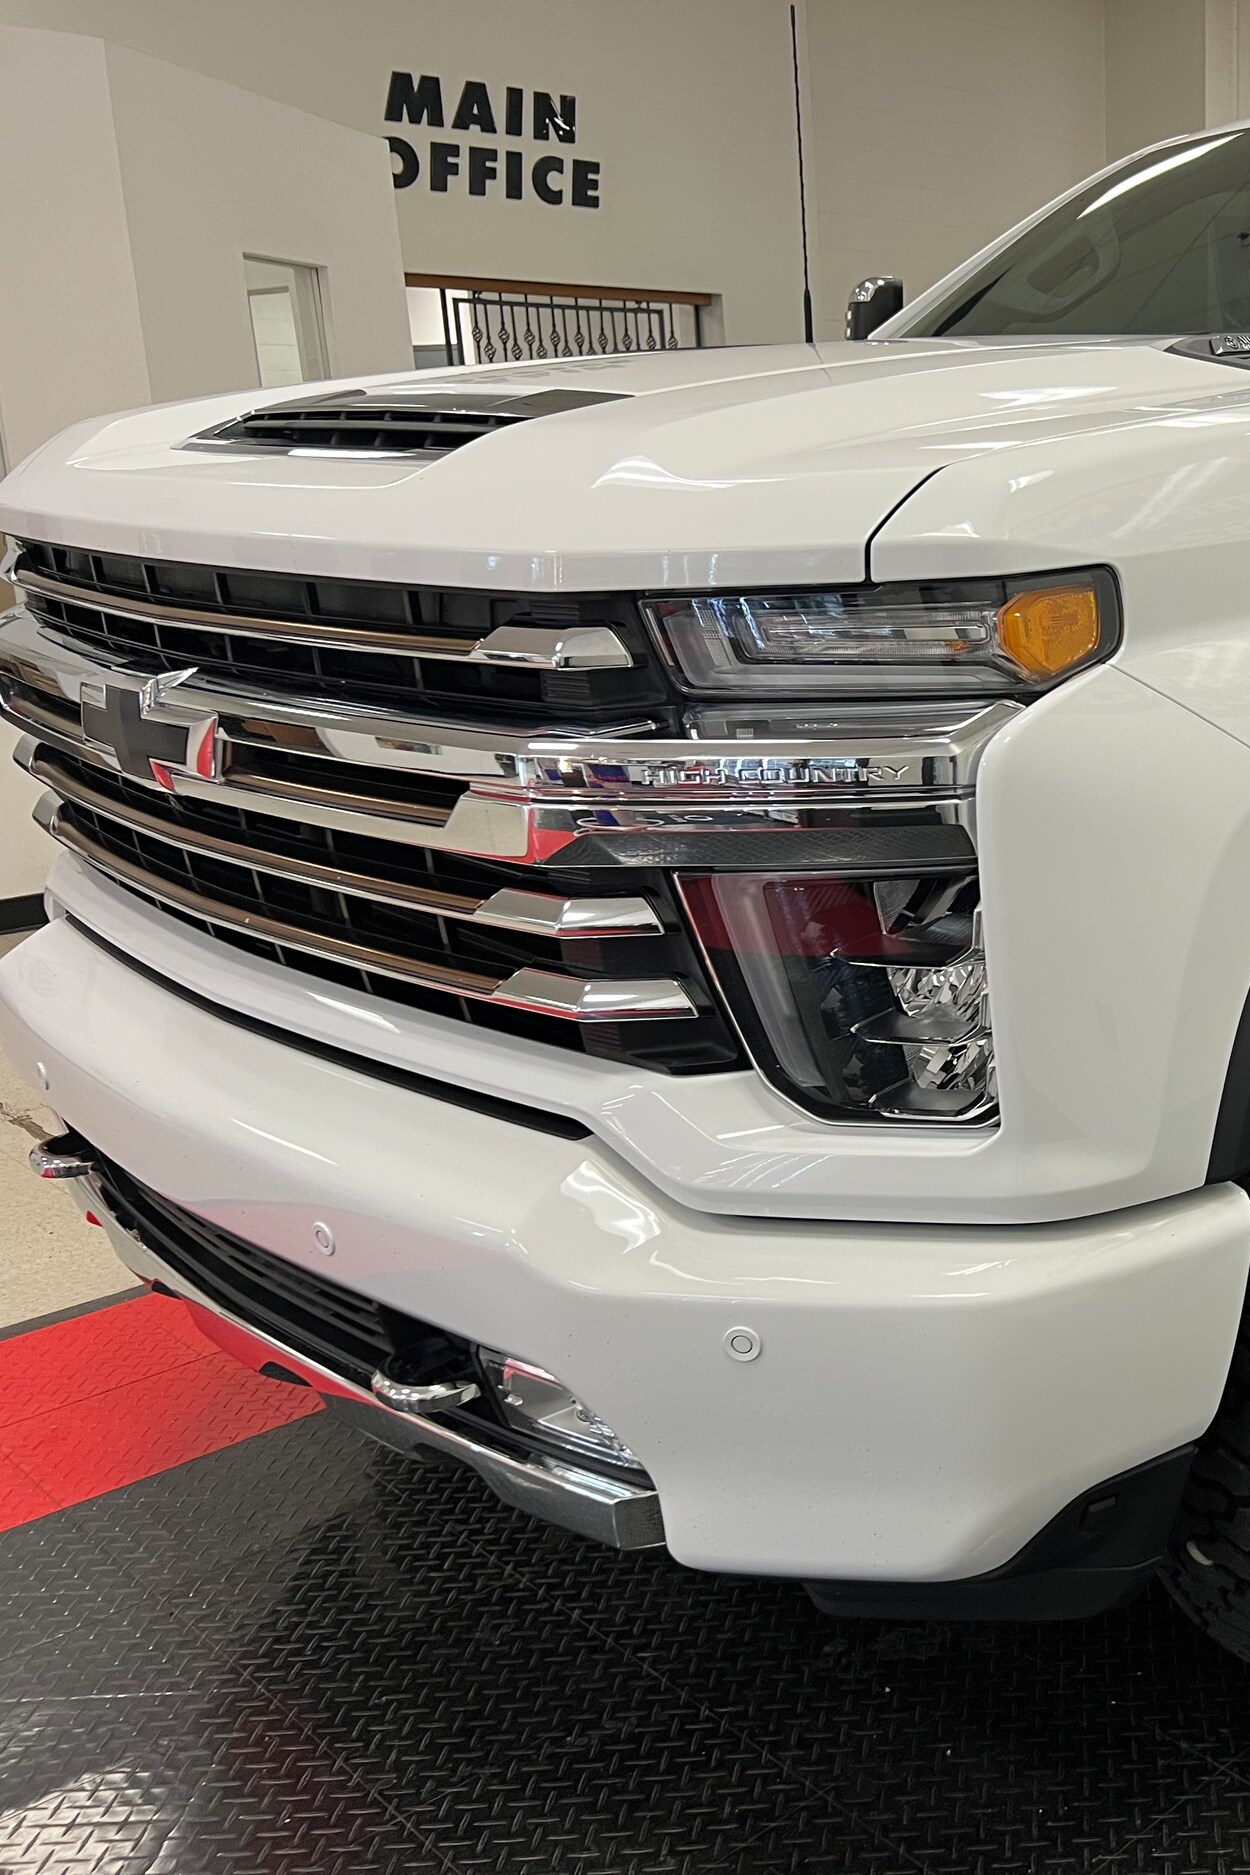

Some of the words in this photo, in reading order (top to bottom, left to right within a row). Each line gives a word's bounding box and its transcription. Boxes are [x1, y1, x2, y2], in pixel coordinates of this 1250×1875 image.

[384, 70, 576, 144] MAIN
[382, 136, 600, 209] OFFICE
[641, 767, 728, 786] HIGH
[738, 764, 910, 785] COUNTRY
